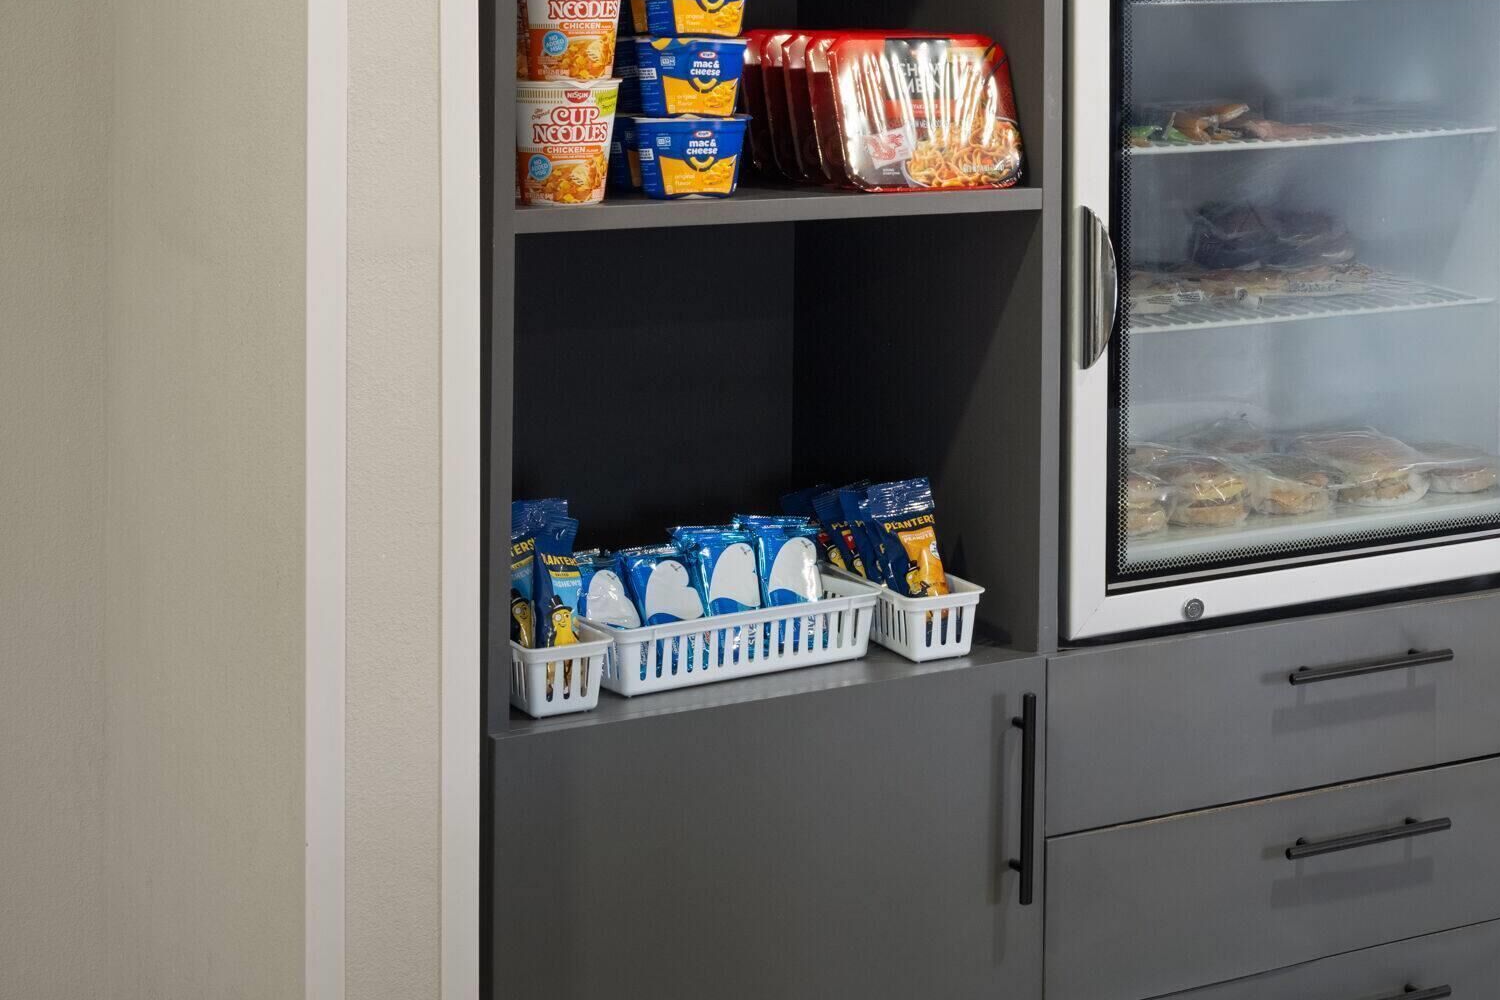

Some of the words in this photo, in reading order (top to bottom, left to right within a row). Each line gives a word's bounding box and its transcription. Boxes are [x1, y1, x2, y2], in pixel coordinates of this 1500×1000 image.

[547, 0, 619, 20] NOODLES
[551, 106, 600, 125] CUP
[532, 122, 609, 144] NOODLES
[546, 146, 586, 154] CHICKEN
